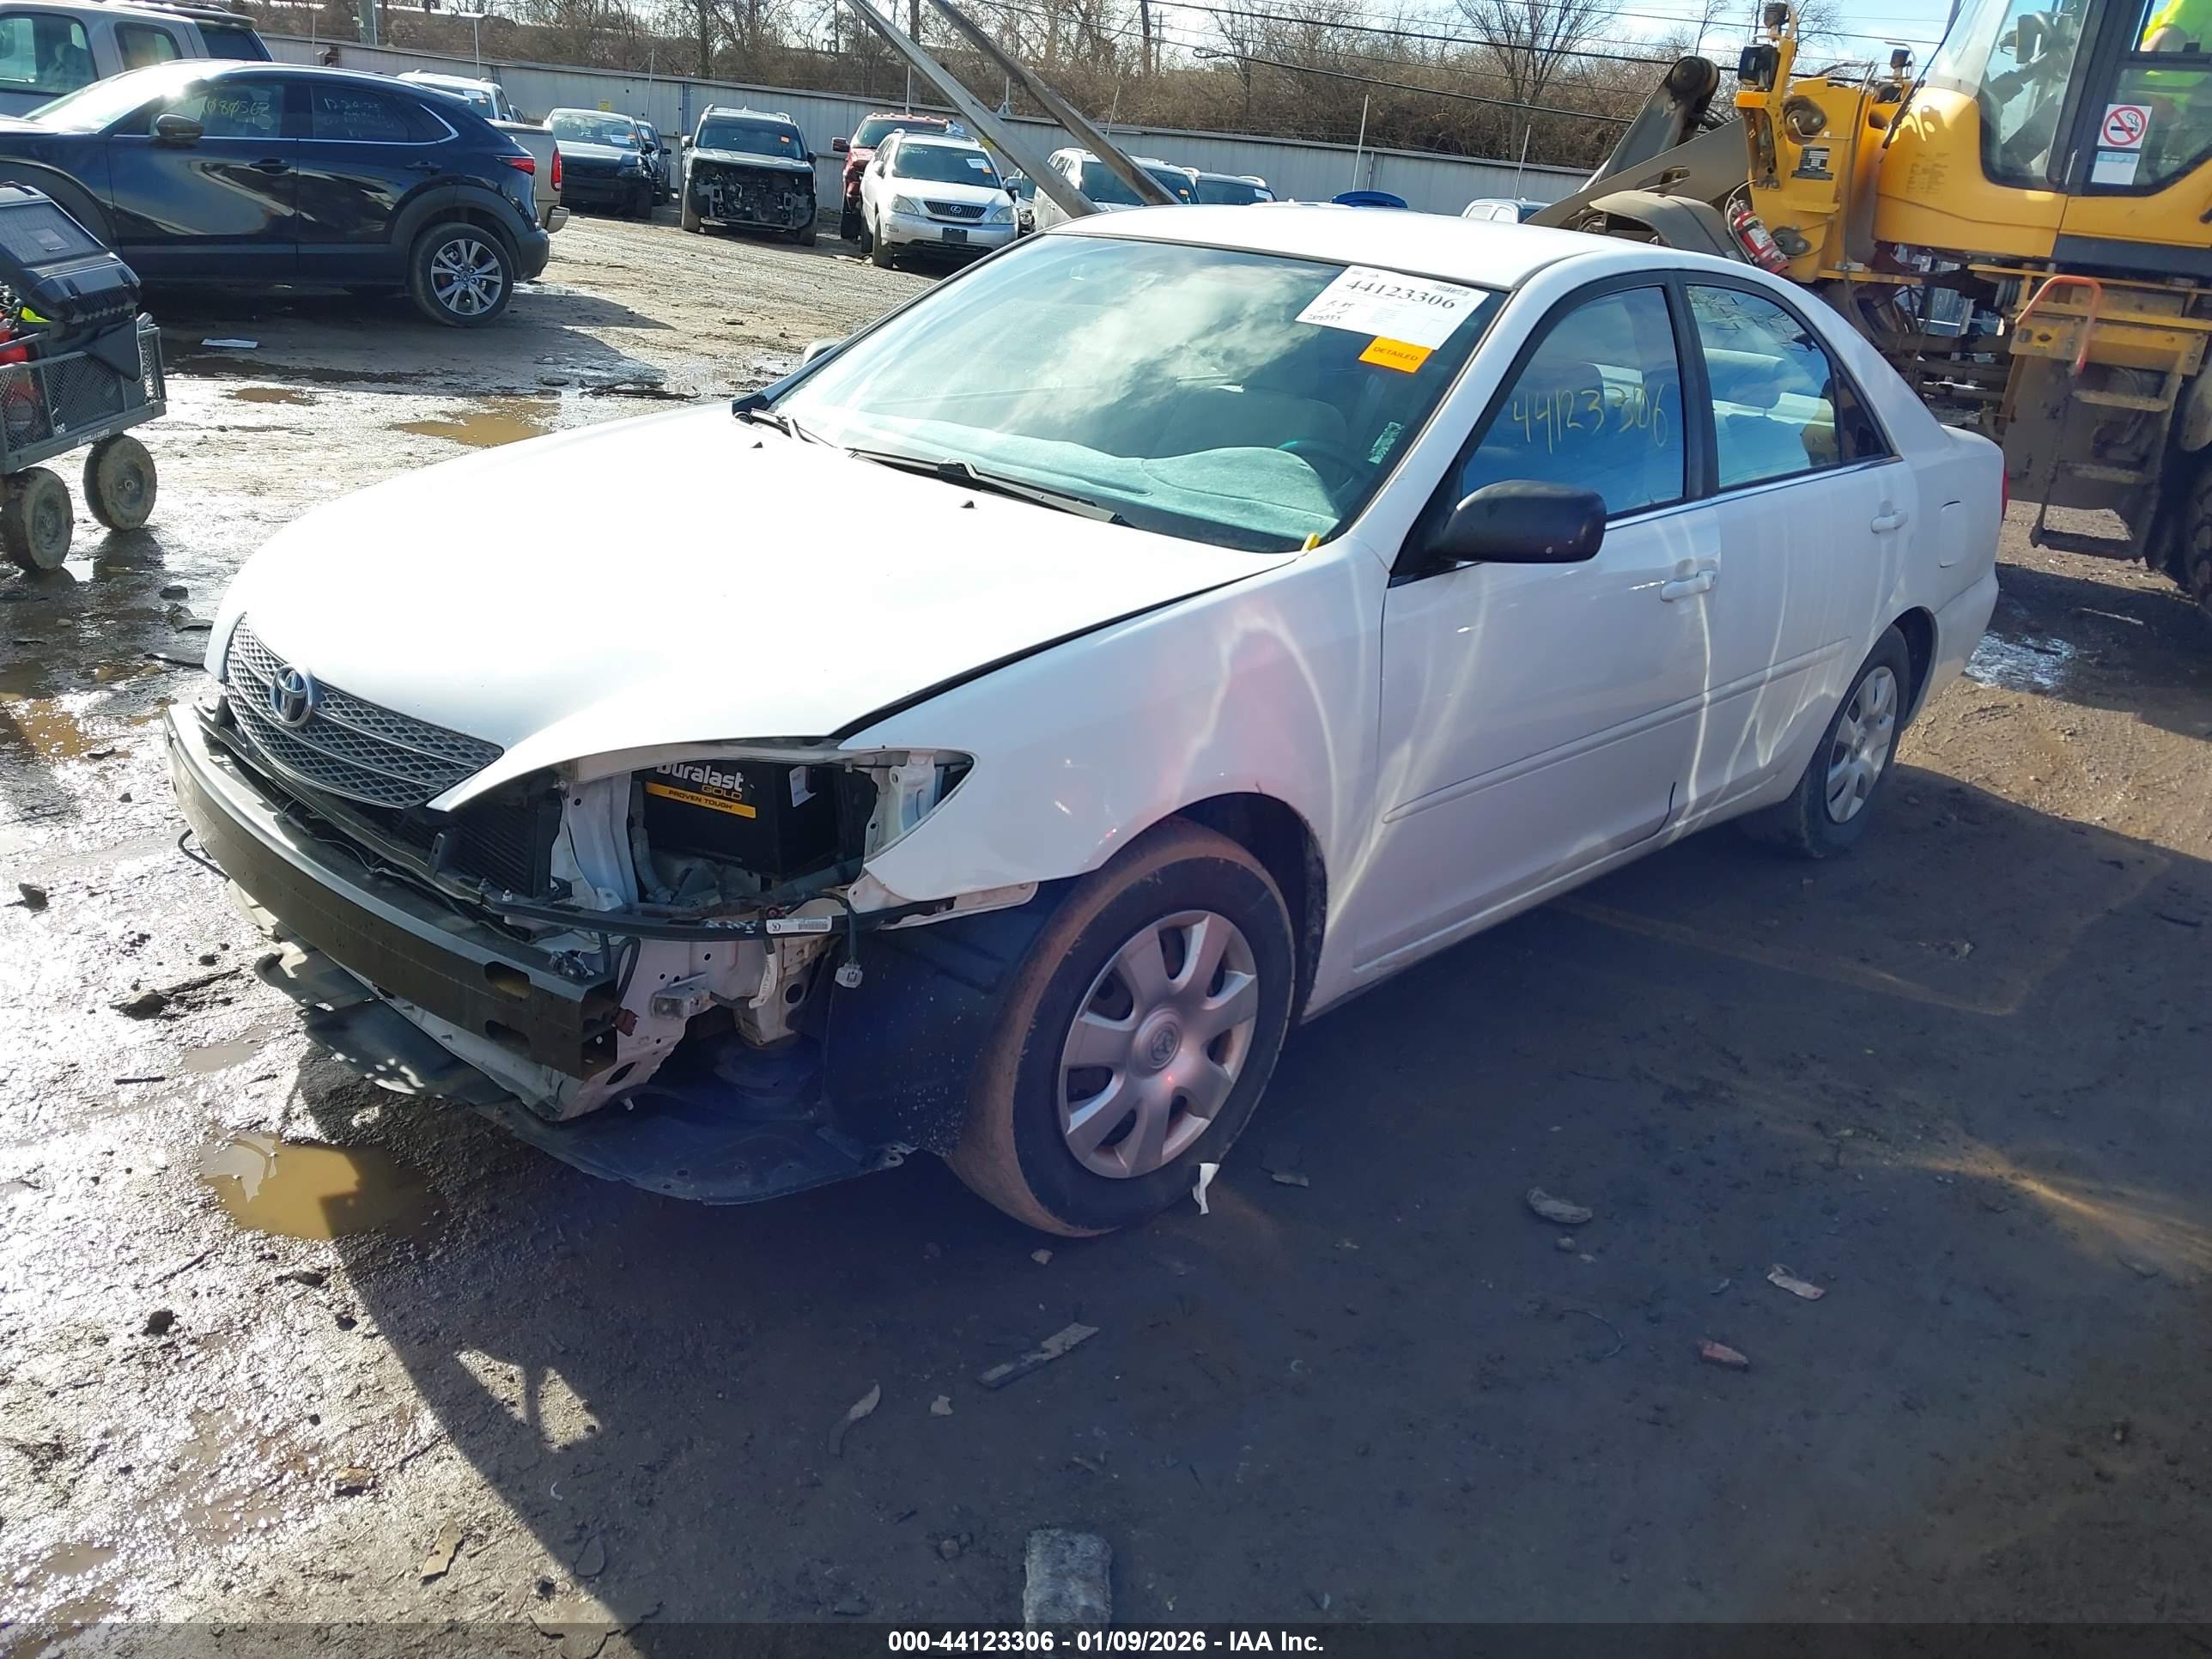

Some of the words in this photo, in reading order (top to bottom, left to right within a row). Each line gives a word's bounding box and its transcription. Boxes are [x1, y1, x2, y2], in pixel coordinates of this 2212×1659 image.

[1346, 280, 1456, 309] 44123306
[1372, 345, 1419, 362] DETAILED
[1513, 383, 1668, 454] 44123306
[656, 762, 744, 793] Duralast
[667, 789, 702, 803] PROVEN
[703, 798, 733, 810] TOUGH
[701, 784, 743, 800] GOLD
